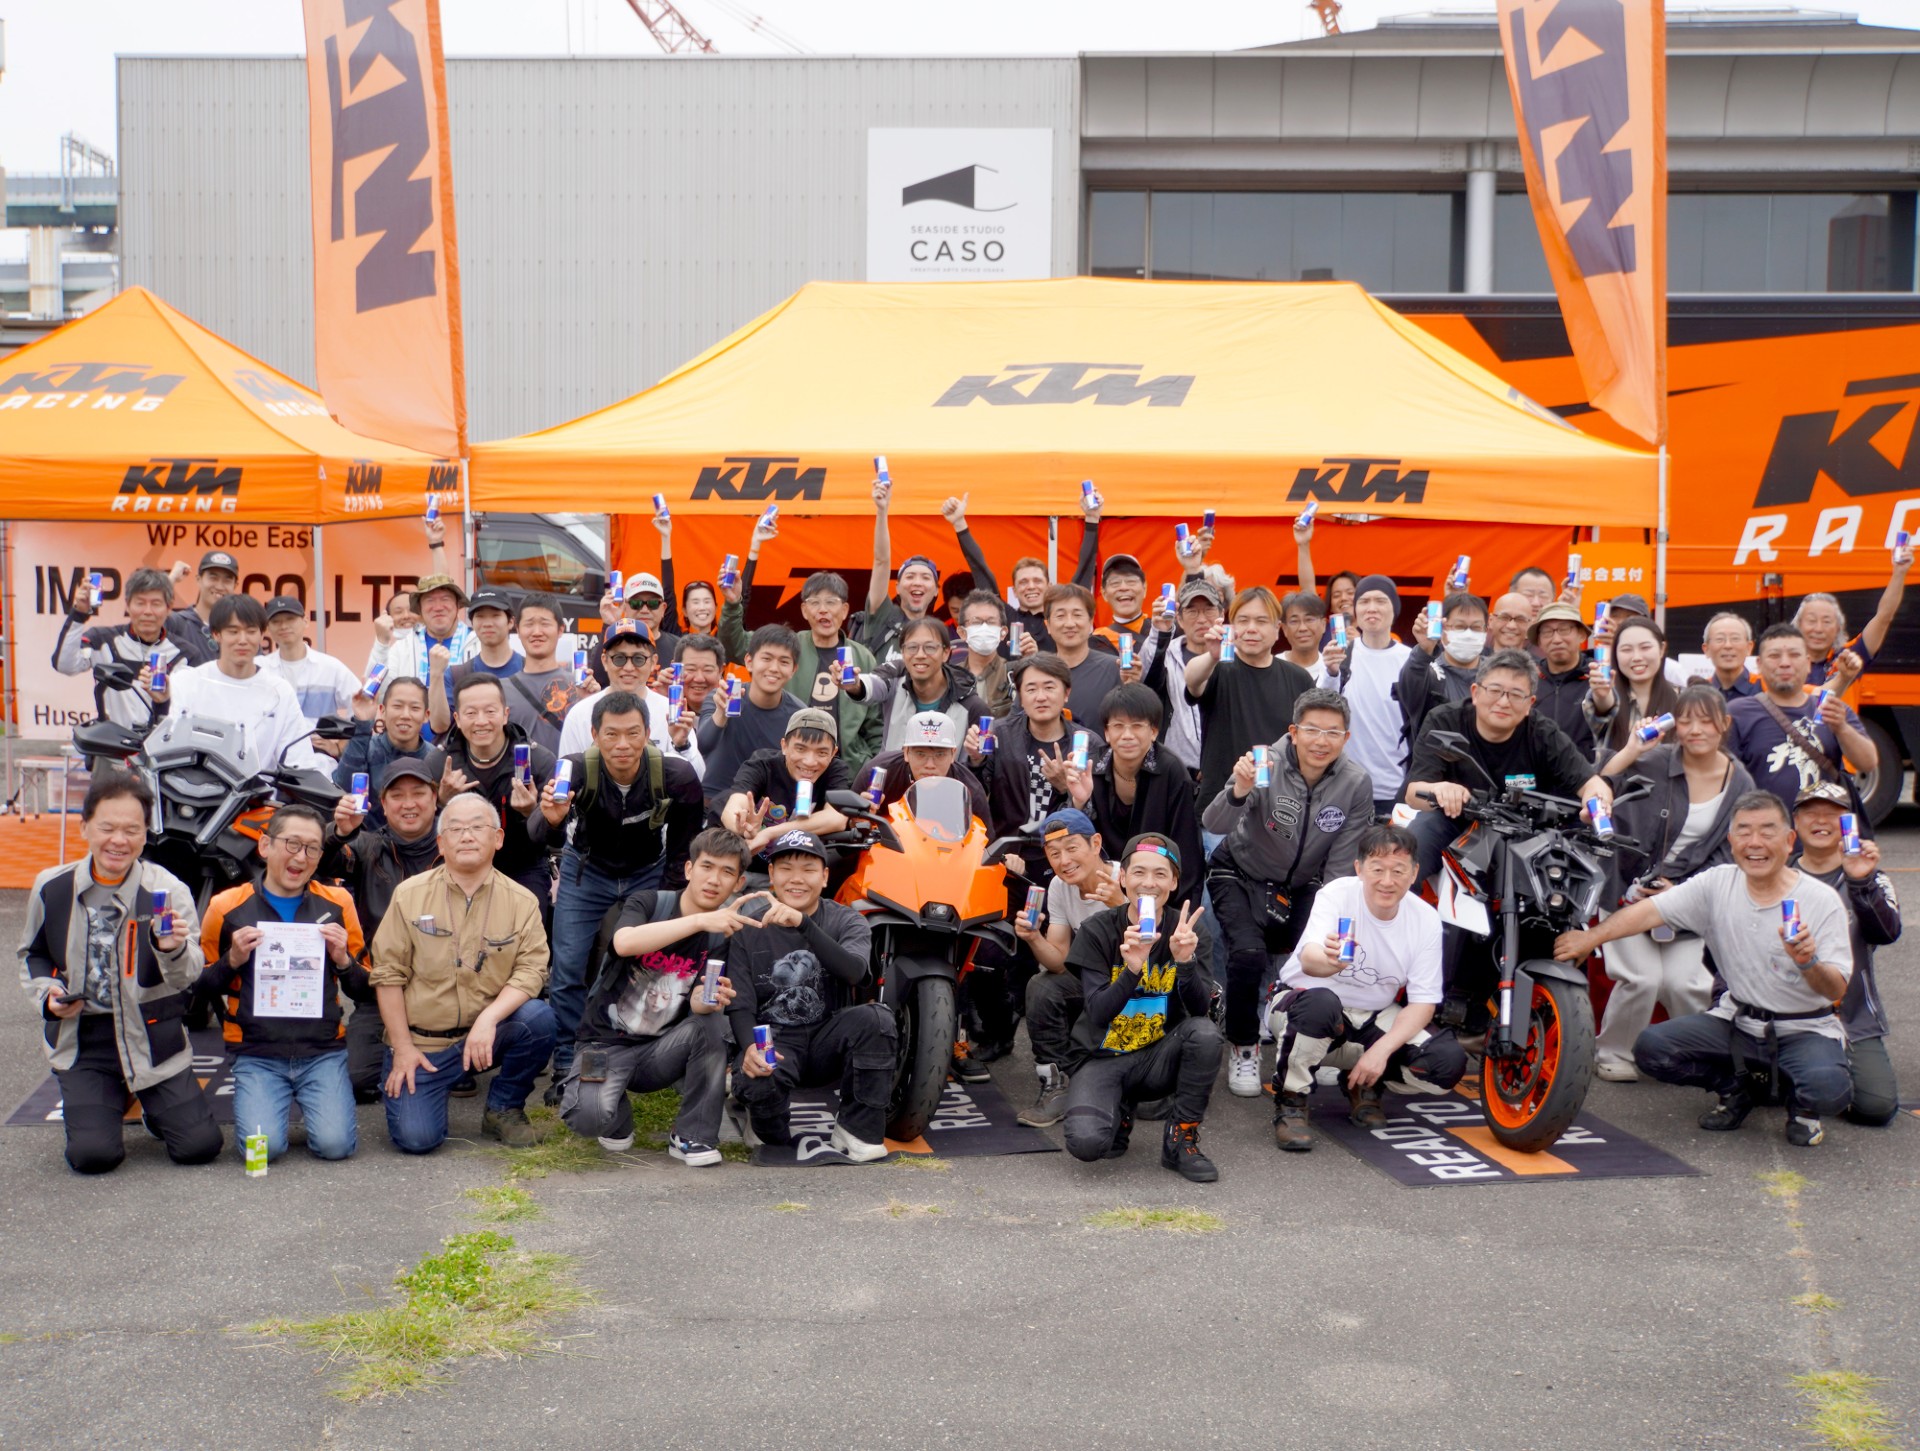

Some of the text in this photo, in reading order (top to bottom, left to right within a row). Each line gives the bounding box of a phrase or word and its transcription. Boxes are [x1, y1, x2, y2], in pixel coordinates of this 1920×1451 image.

[911, 225, 1005, 234] SEASIDE STUDIO
[910, 240, 1004, 261] CASO
[0, 362, 187, 396] KTM
[931, 362, 1196, 407] KTM
[119, 459, 243, 496] KTM
[345, 458, 382, 494] KTM
[426, 458, 459, 491] KTM
[690, 457, 827, 501] KTM
[1287, 457, 1430, 504] KTM
[147, 524, 187, 546] WP
[195, 525, 259, 548] Kobe
[1405, 1101, 1486, 1125] TO
[1371, 1117, 1503, 1180] READ
